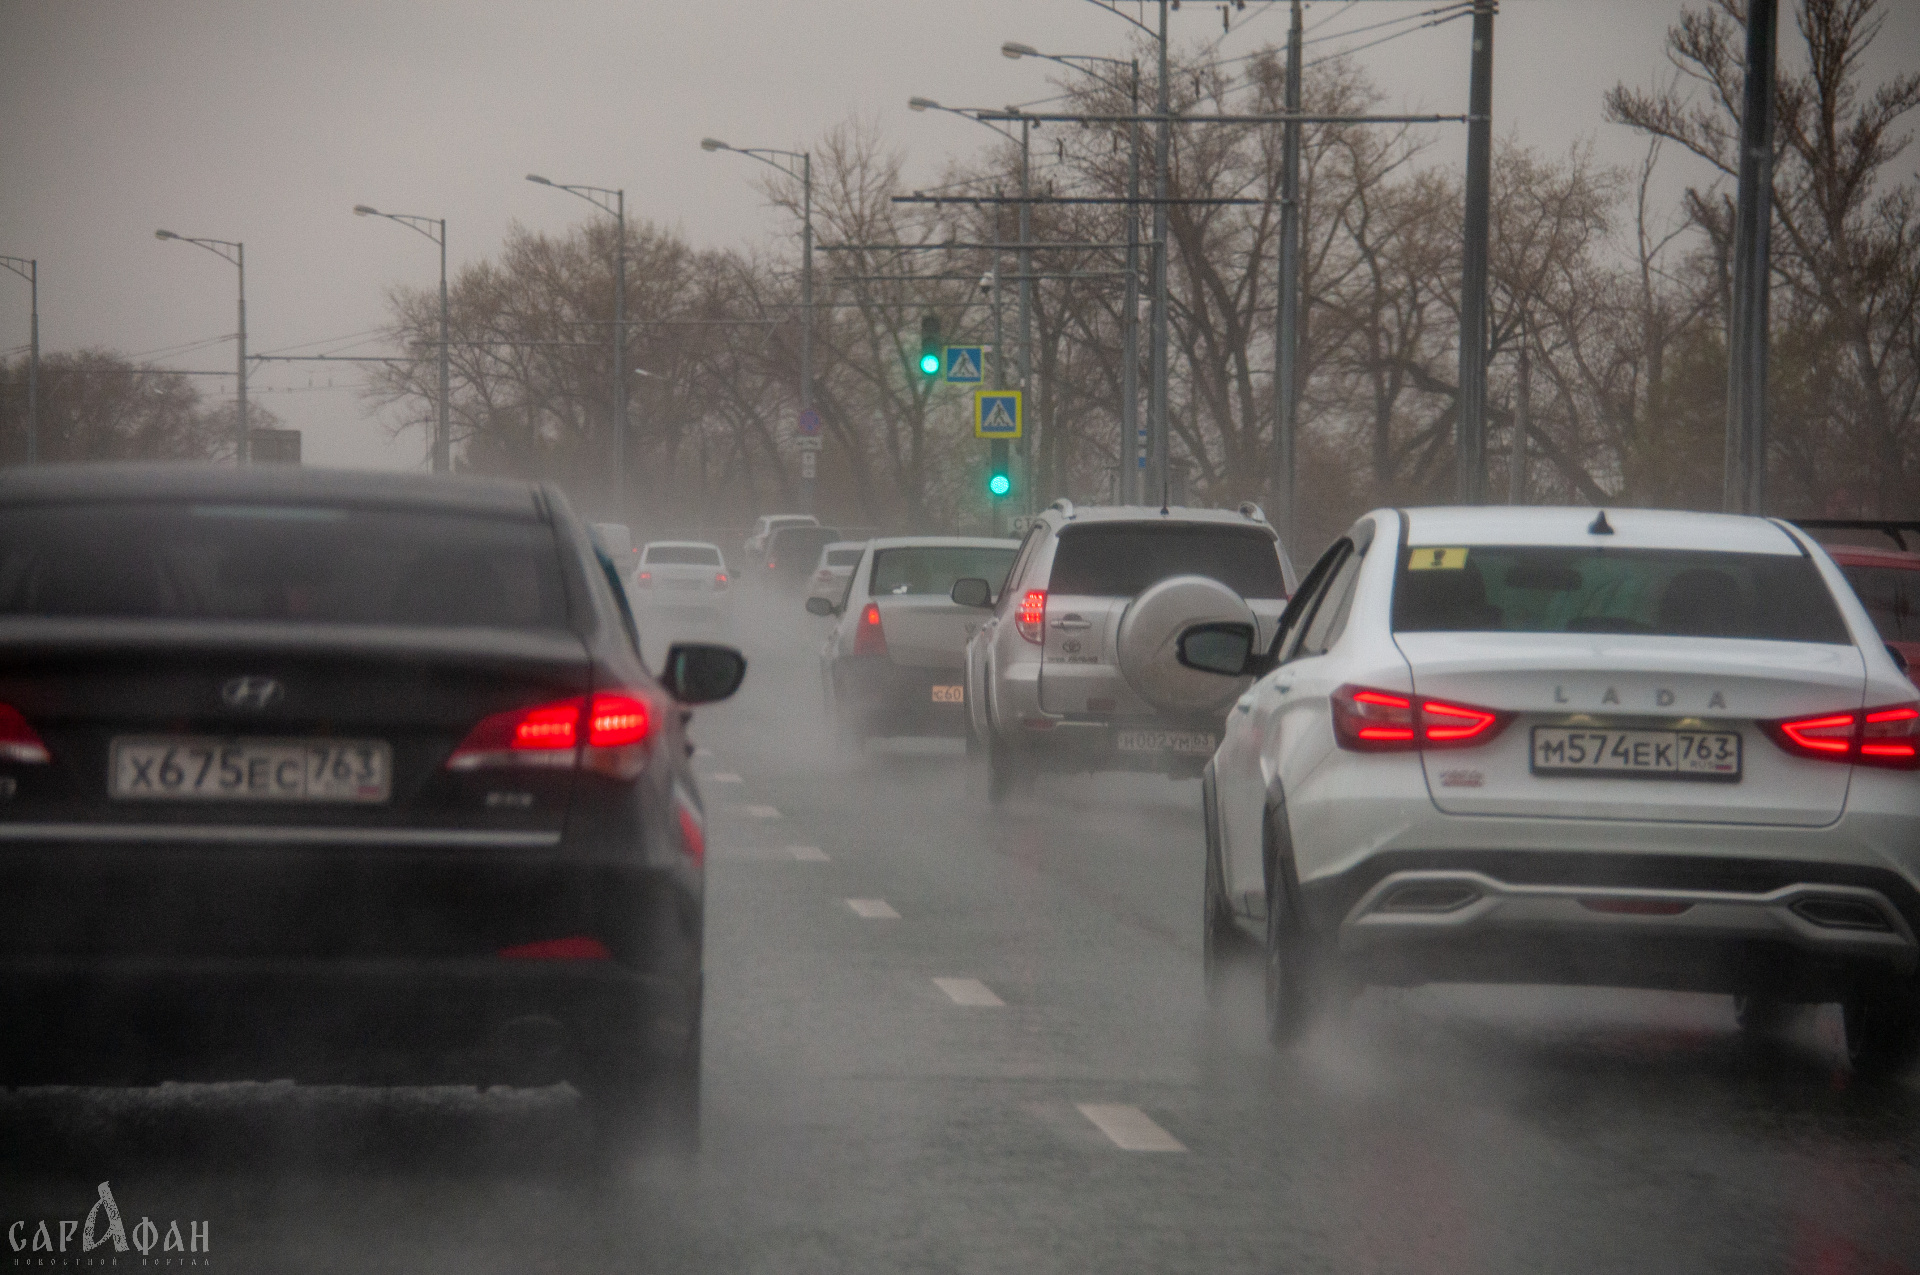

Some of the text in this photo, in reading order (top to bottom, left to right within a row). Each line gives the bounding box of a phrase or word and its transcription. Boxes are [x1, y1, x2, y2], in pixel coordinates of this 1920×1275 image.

[1554, 686, 1726, 709] LADA
[1542, 733, 1730, 767] М574ЕК 763
[130, 746, 375, 790] Х675ЕС 763
